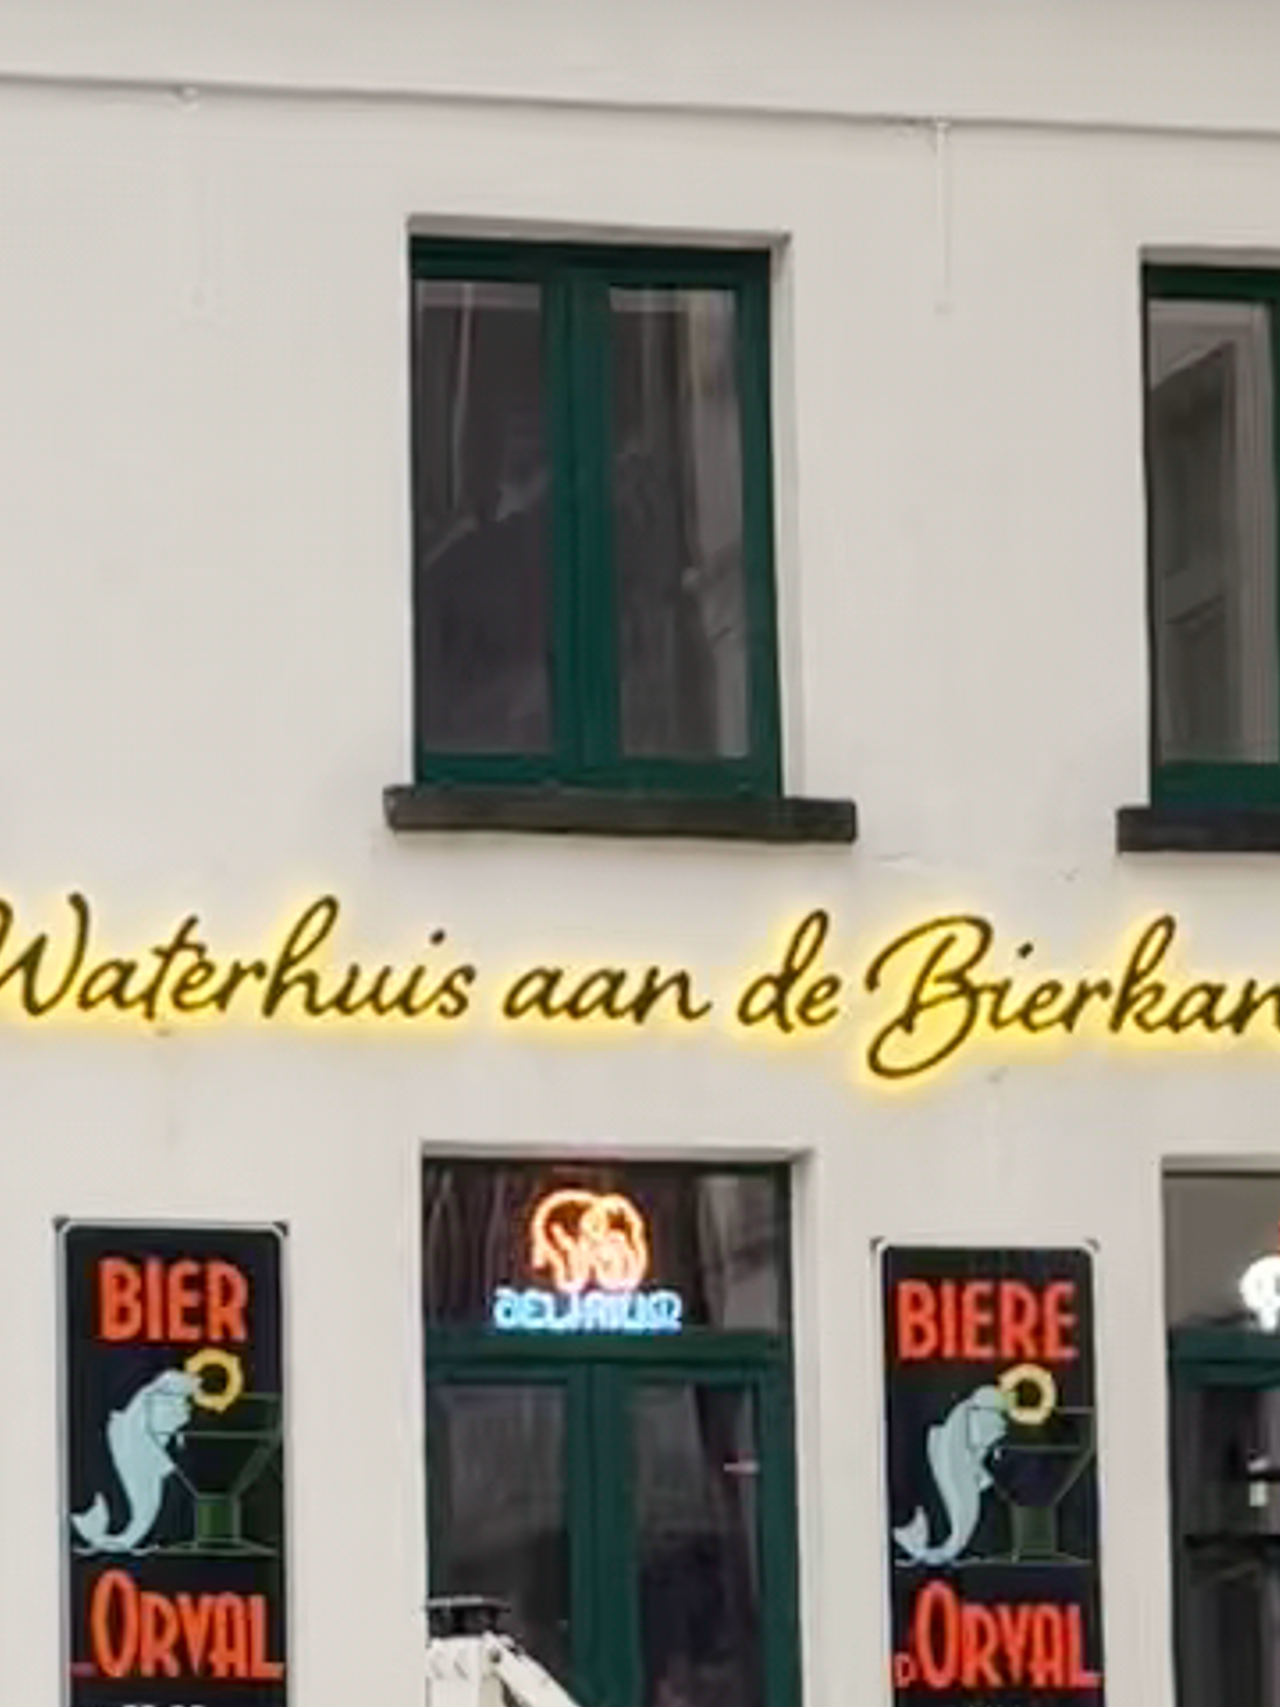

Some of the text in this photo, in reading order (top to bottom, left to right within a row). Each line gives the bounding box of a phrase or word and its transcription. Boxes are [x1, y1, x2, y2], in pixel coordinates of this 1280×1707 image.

[501, 960, 712, 1024] aan
[736, 909, 843, 1034] de
[97, 1256, 250, 1343] BIER
[896, 1279, 1079, 1361] BIERE
[90, 1568, 286, 1679] ORVAL
